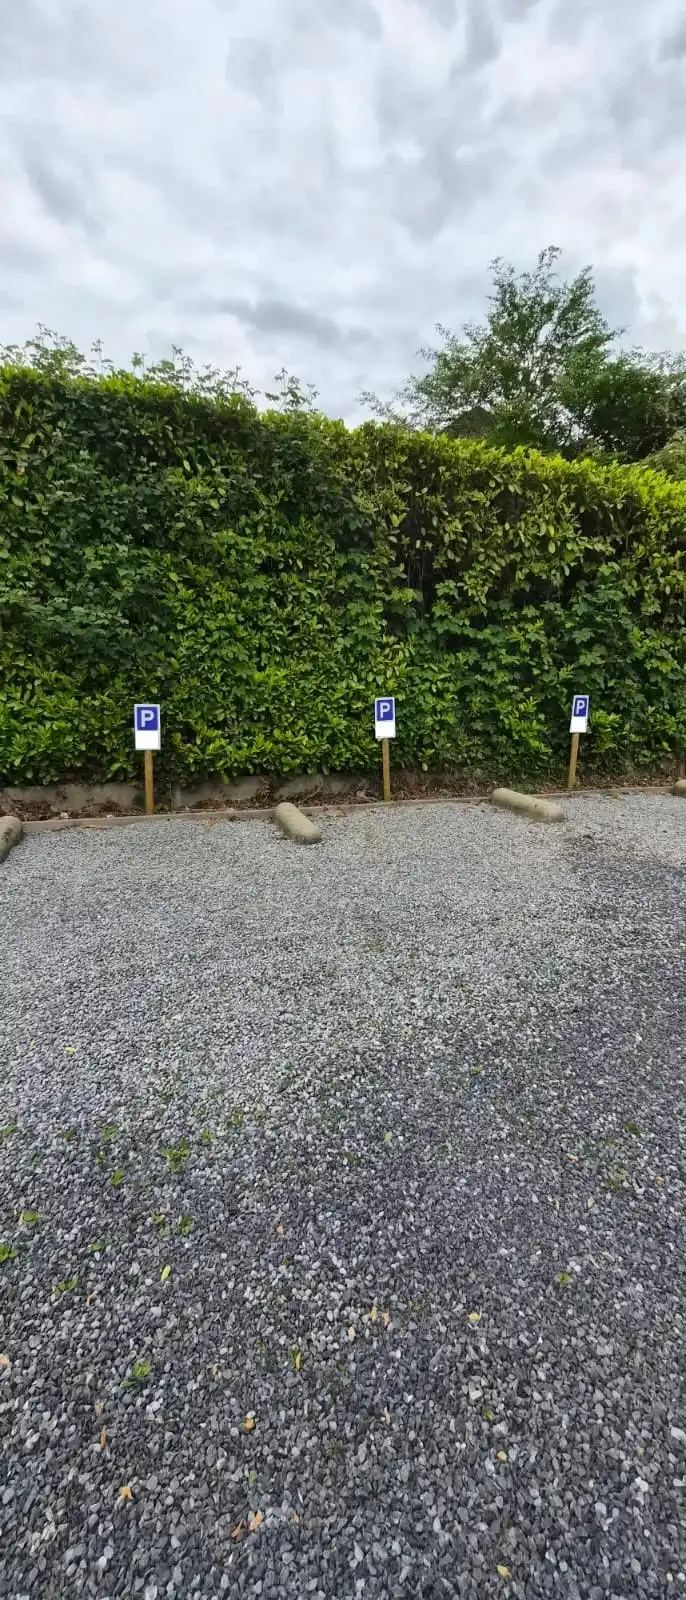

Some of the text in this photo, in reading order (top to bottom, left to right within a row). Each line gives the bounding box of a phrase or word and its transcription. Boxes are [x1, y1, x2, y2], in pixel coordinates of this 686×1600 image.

[379, 702, 390, 718] P
[576, 700, 585, 714] P
[141, 709, 154, 727] P
